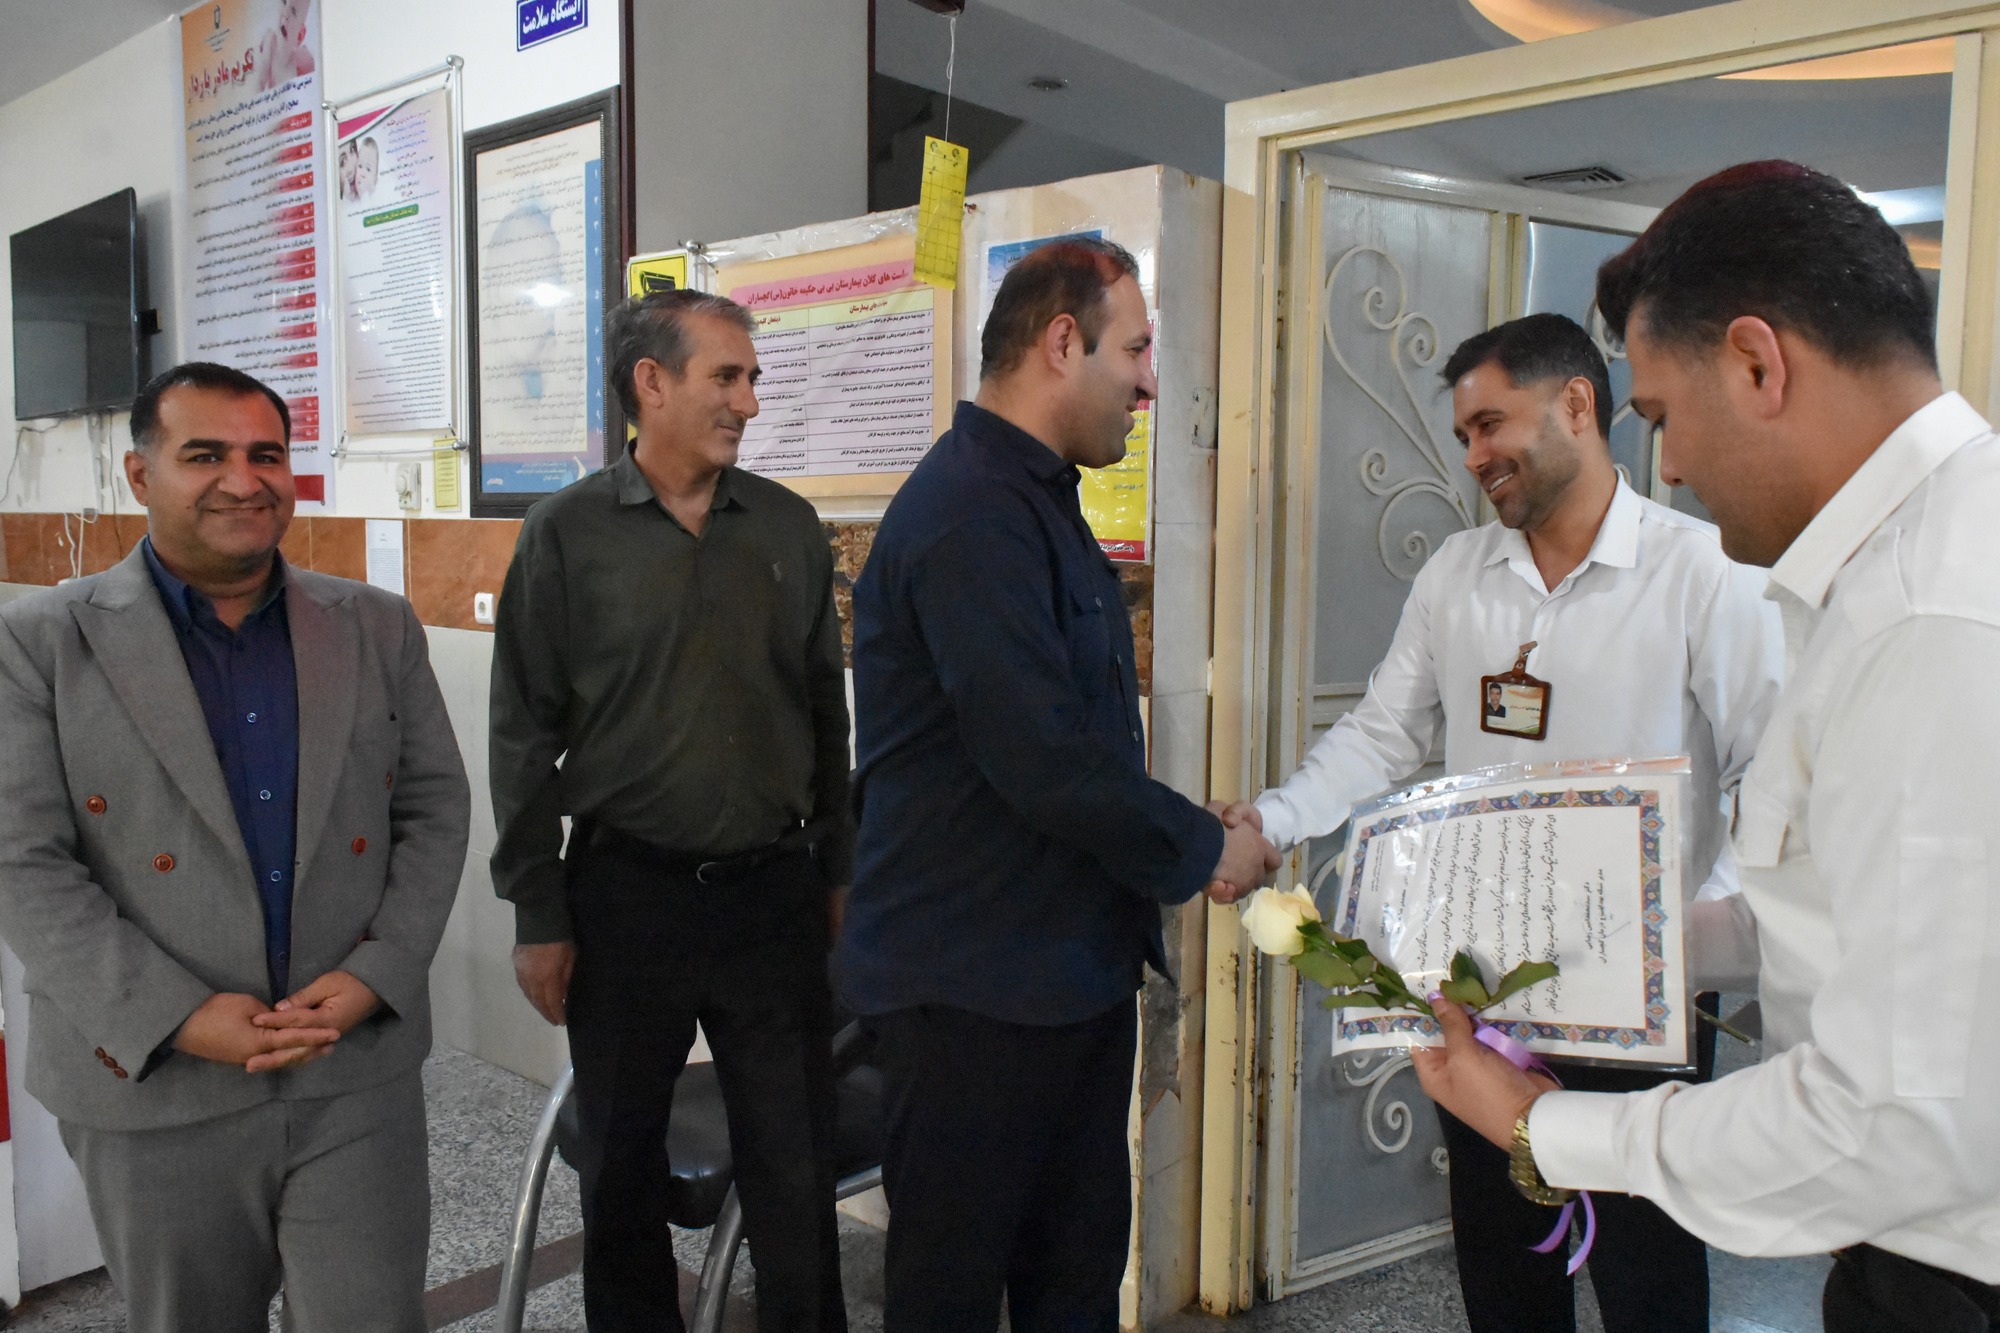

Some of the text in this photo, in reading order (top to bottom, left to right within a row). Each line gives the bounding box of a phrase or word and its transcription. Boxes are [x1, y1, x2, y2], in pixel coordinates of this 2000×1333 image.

[523, 5, 549, 34] سلامت
[187, 47, 254, 104] تکریم مادر باردار
[835, 278, 861, 291] بیمارستان
[862, 274, 875, 287] کلان
[878, 273, 890, 285] های
[799, 285, 815, 295] حکیمه
[816, 286, 825, 294] بی
[826, 284, 834, 293] بی
[849, 305, 868, 313] بیمارستان
[1540, 855, 1558, 872] تبریک
[1544, 872, 1555, 885] عرض
[1584, 882, 1592, 893] دکتر
[1490, 889, 1509, 920] گرامیداشت
[1597, 896, 1605, 917] بهداشت
[1598, 922, 1607, 939] درمان
[1542, 948, 1560, 961] توفیق
[1598, 940, 1607, 964] گچساران
